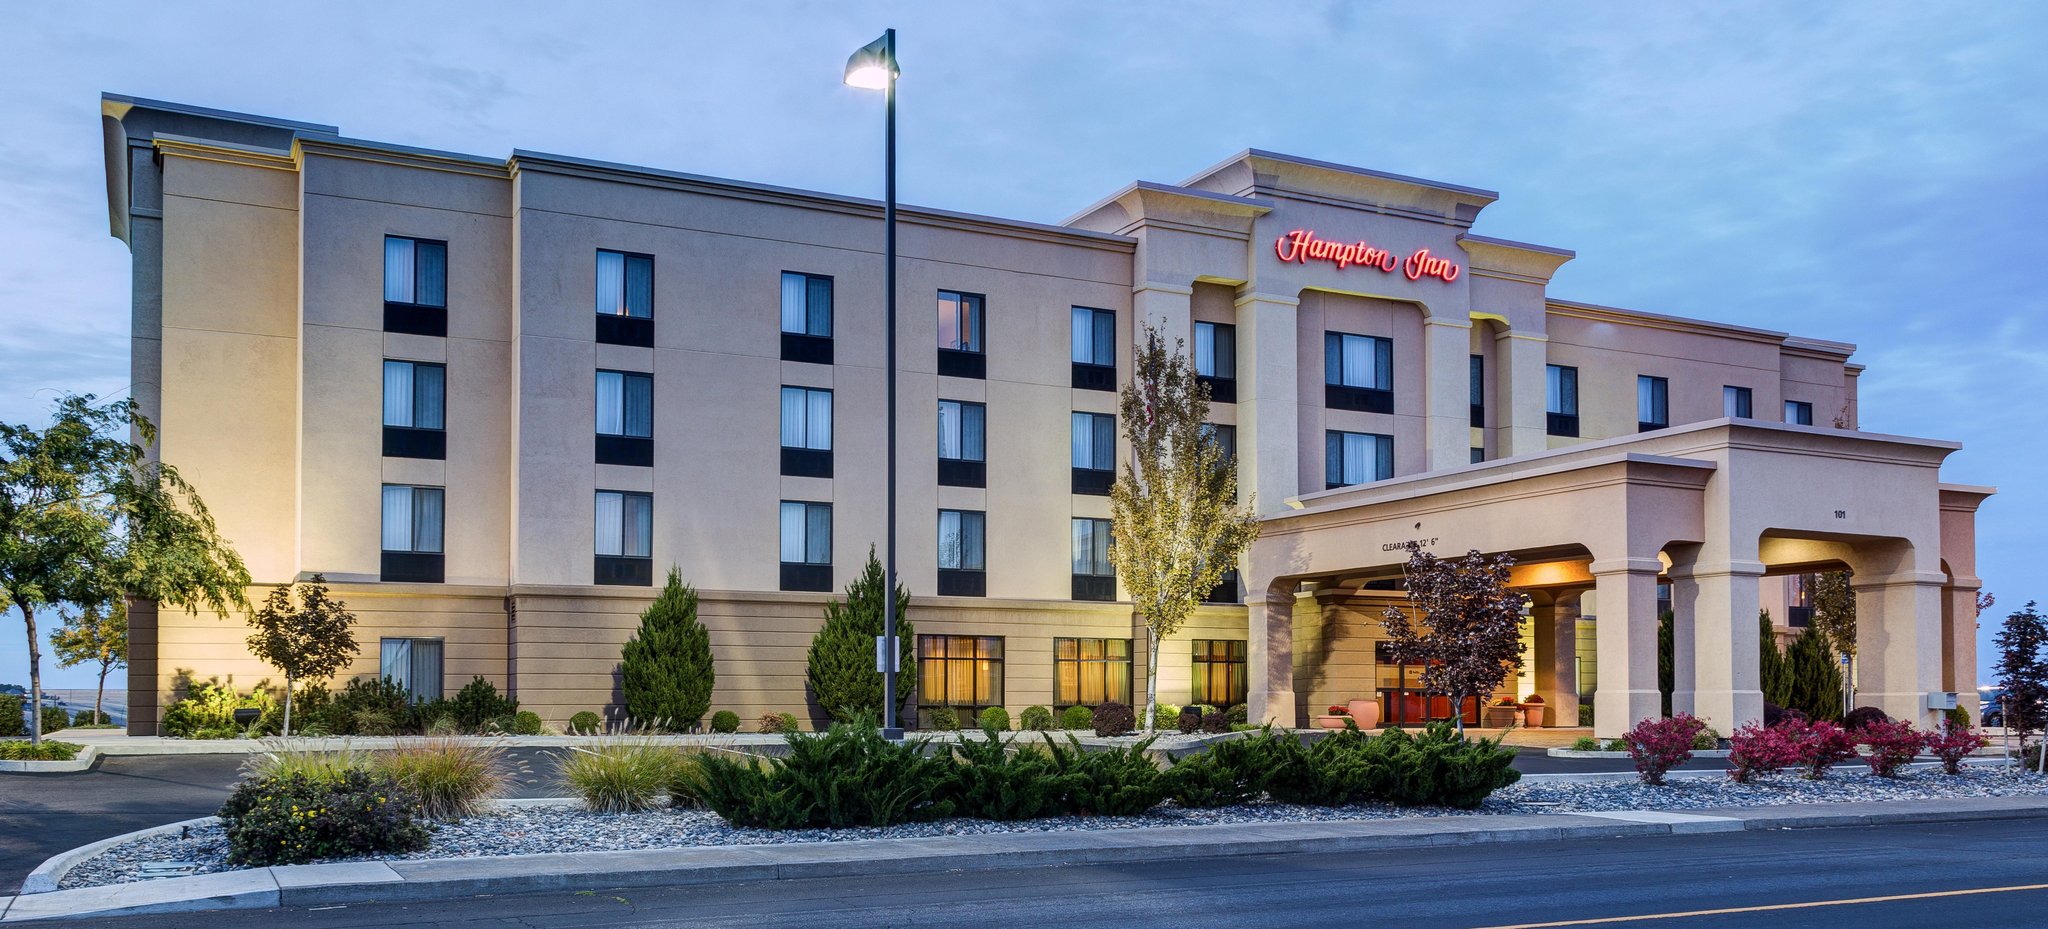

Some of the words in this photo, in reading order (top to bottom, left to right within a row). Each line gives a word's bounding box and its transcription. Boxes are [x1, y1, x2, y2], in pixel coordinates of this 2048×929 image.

[1275, 230, 1397, 272] Hampton
[1403, 249, 1459, 282] Inn
[1834, 510, 1846, 519] 101
[1382, 540, 1417, 551] CLEARA
